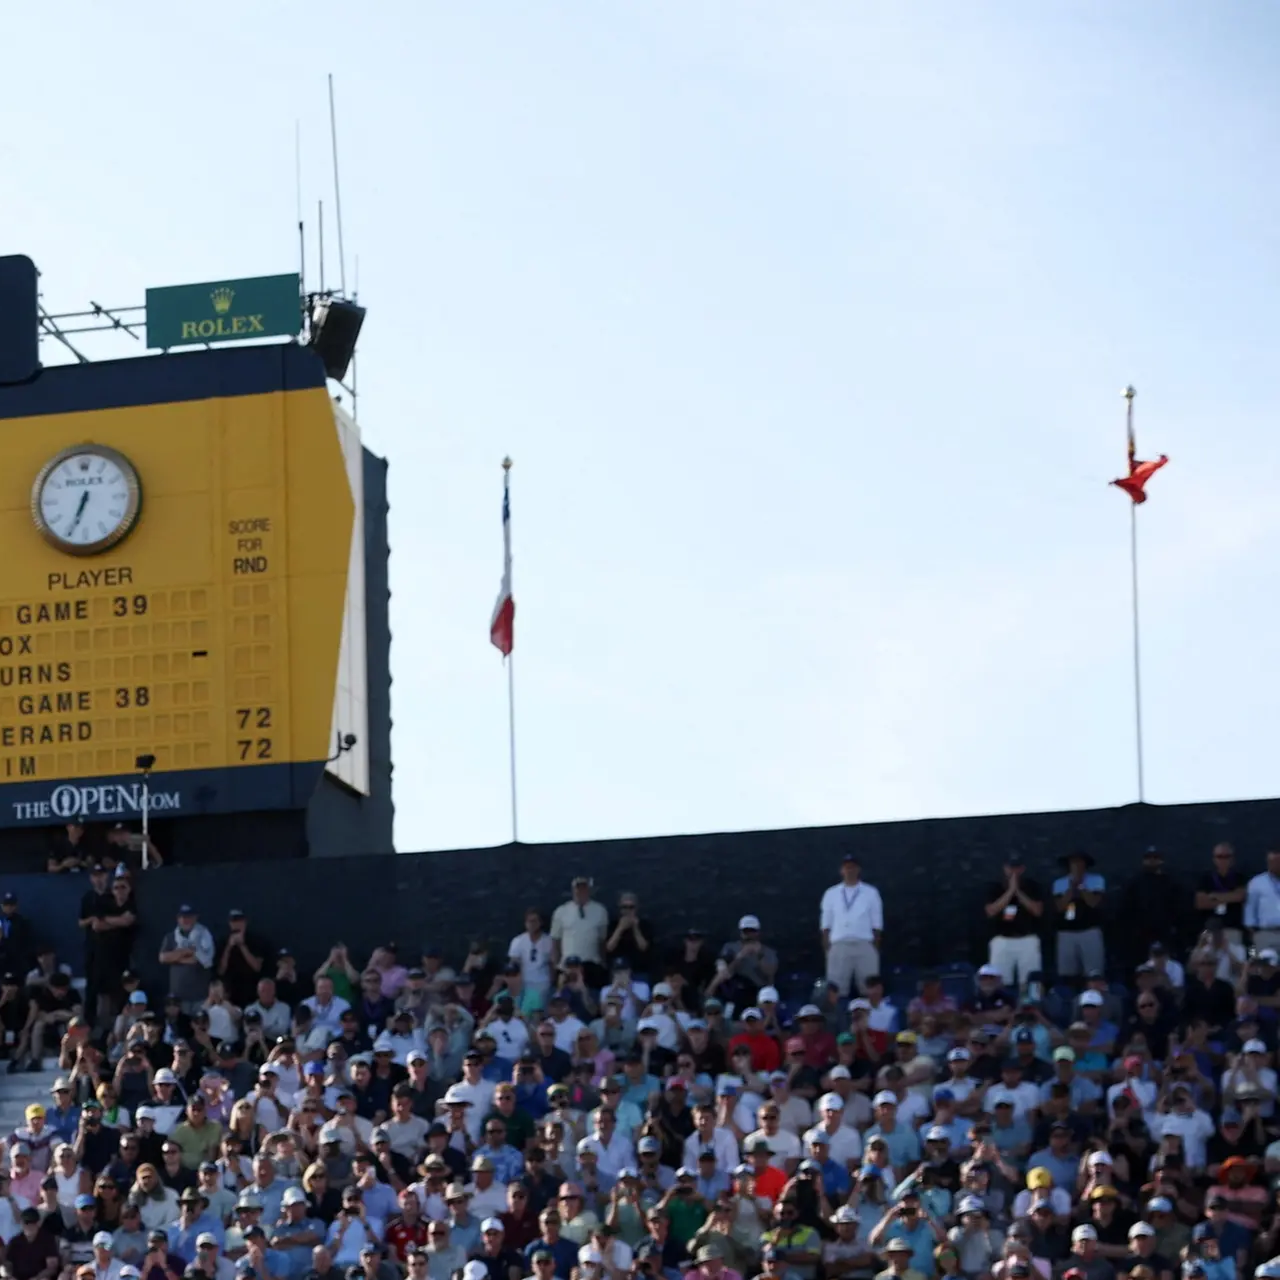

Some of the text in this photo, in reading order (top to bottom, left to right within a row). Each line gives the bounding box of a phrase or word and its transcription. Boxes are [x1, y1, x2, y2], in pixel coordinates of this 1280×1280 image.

[182, 314, 264, 339] ROLEX
[66, 477, 102, 486] ROLEX
[229, 518, 269, 534] SCORE
[238, 538, 262, 551] FOR
[234, 556, 267, 573] RND
[48, 567, 132, 590] PLAYER
[17, 595, 147, 624] GAME 39
[19, 687, 149, 714] GAME 38
[236, 708, 271, 728] 72
[237, 738, 271, 759] 72
